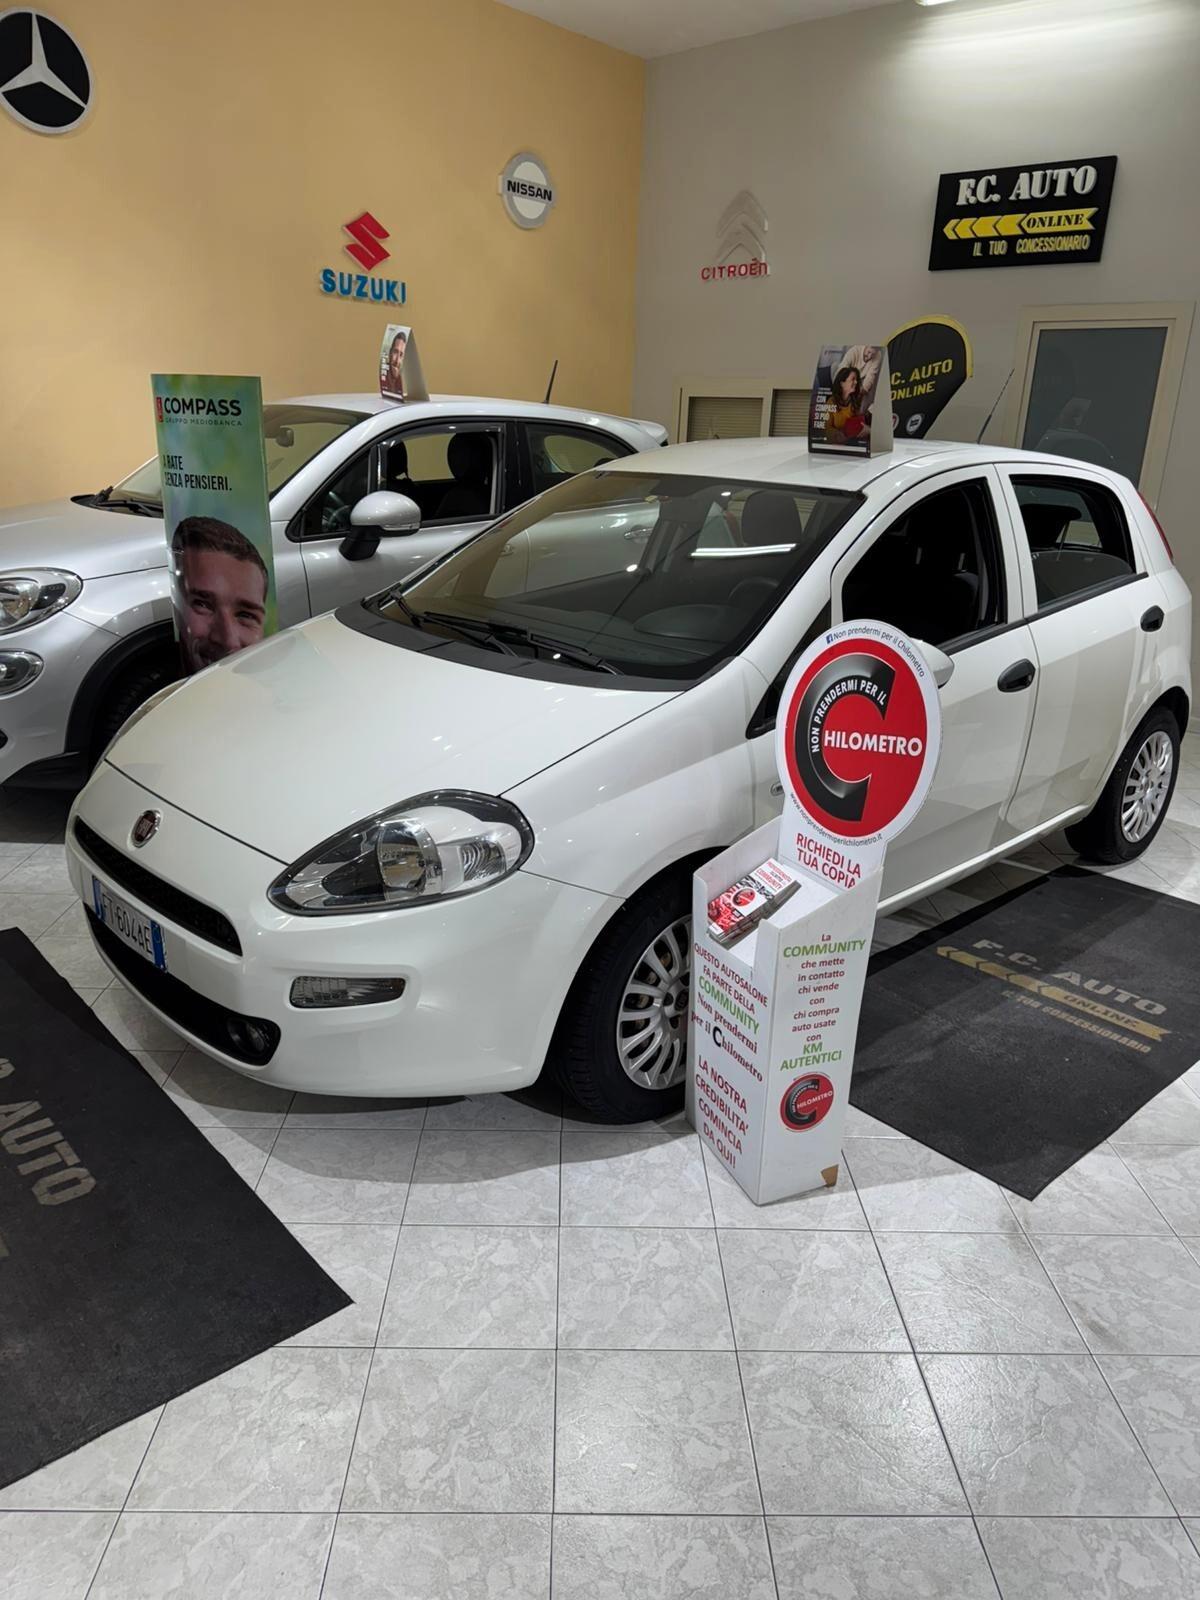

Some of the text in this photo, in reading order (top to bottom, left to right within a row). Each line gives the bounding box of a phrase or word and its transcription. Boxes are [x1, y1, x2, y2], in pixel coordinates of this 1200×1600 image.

[507, 180, 552, 202] NISSAN
[956, 165, 1097, 206] F.C. AUTO
[1026, 213, 1084, 229] ONLINE
[973, 234, 1090, 257] IL TUO CONCESSIONARIO
[321, 268, 406, 304] SUZUKI
[910, 359, 953, 382] AUTO
[816, 395, 827, 403] CON
[890, 381, 936, 400] ONLINE
[164, 397, 242, 417] COMPASS
[815, 404, 838, 413] COMPASS
[190, 418, 243, 427] MEDIOBANCA
[167, 455, 184, 471] RATE
[184, 474, 233, 492] PENSIERI.
[833, 626, 925, 678] Non prendermi per il Chilometro
[811, 679, 887, 753] NON PRENDERMI PER IL
[796, 833, 861, 879] RICHIEDI LA
[797, 848, 819, 871] TUA
[783, 940, 866, 958] COMMUNITY
[821, 934, 832, 942] La
[694, 942, 720, 968] QUESTO
[721, 964, 768, 1007] AUTOSALONE
[801, 958, 845, 969] che mette
[797, 970, 845, 982] in contatto
[972, 939, 1168, 1015] F.C. AUTO
[703, 965, 755, 1014] FA PARTE DELLA
[798, 982, 839, 994] chi vende
[699, 975, 760, 1035] COMMUNITY
[809, 997, 825, 1005] con
[1064, 995, 1139, 1028] ONLINE
[697, 992, 713, 1014] Non
[714, 1010, 757, 1054] prendermi
[793, 1007, 840, 1020] chi compra
[791, 1019, 837, 1032] auto usate
[691, 1011, 763, 1082] per il Chilometro
[803, 1042, 823, 1055] KM
[806, 1034, 822, 1042] con
[780, 1050, 842, 1071] AUTENTICI
[698, 1054, 747, 1114] LA NOSTRA
[696, 1074, 749, 1135] CREDIBILITA'
[699, 1098, 742, 1154] COMINCIA
[703, 1122, 715, 1144] DA
[0, 1101, 96, 1205] AUTO
